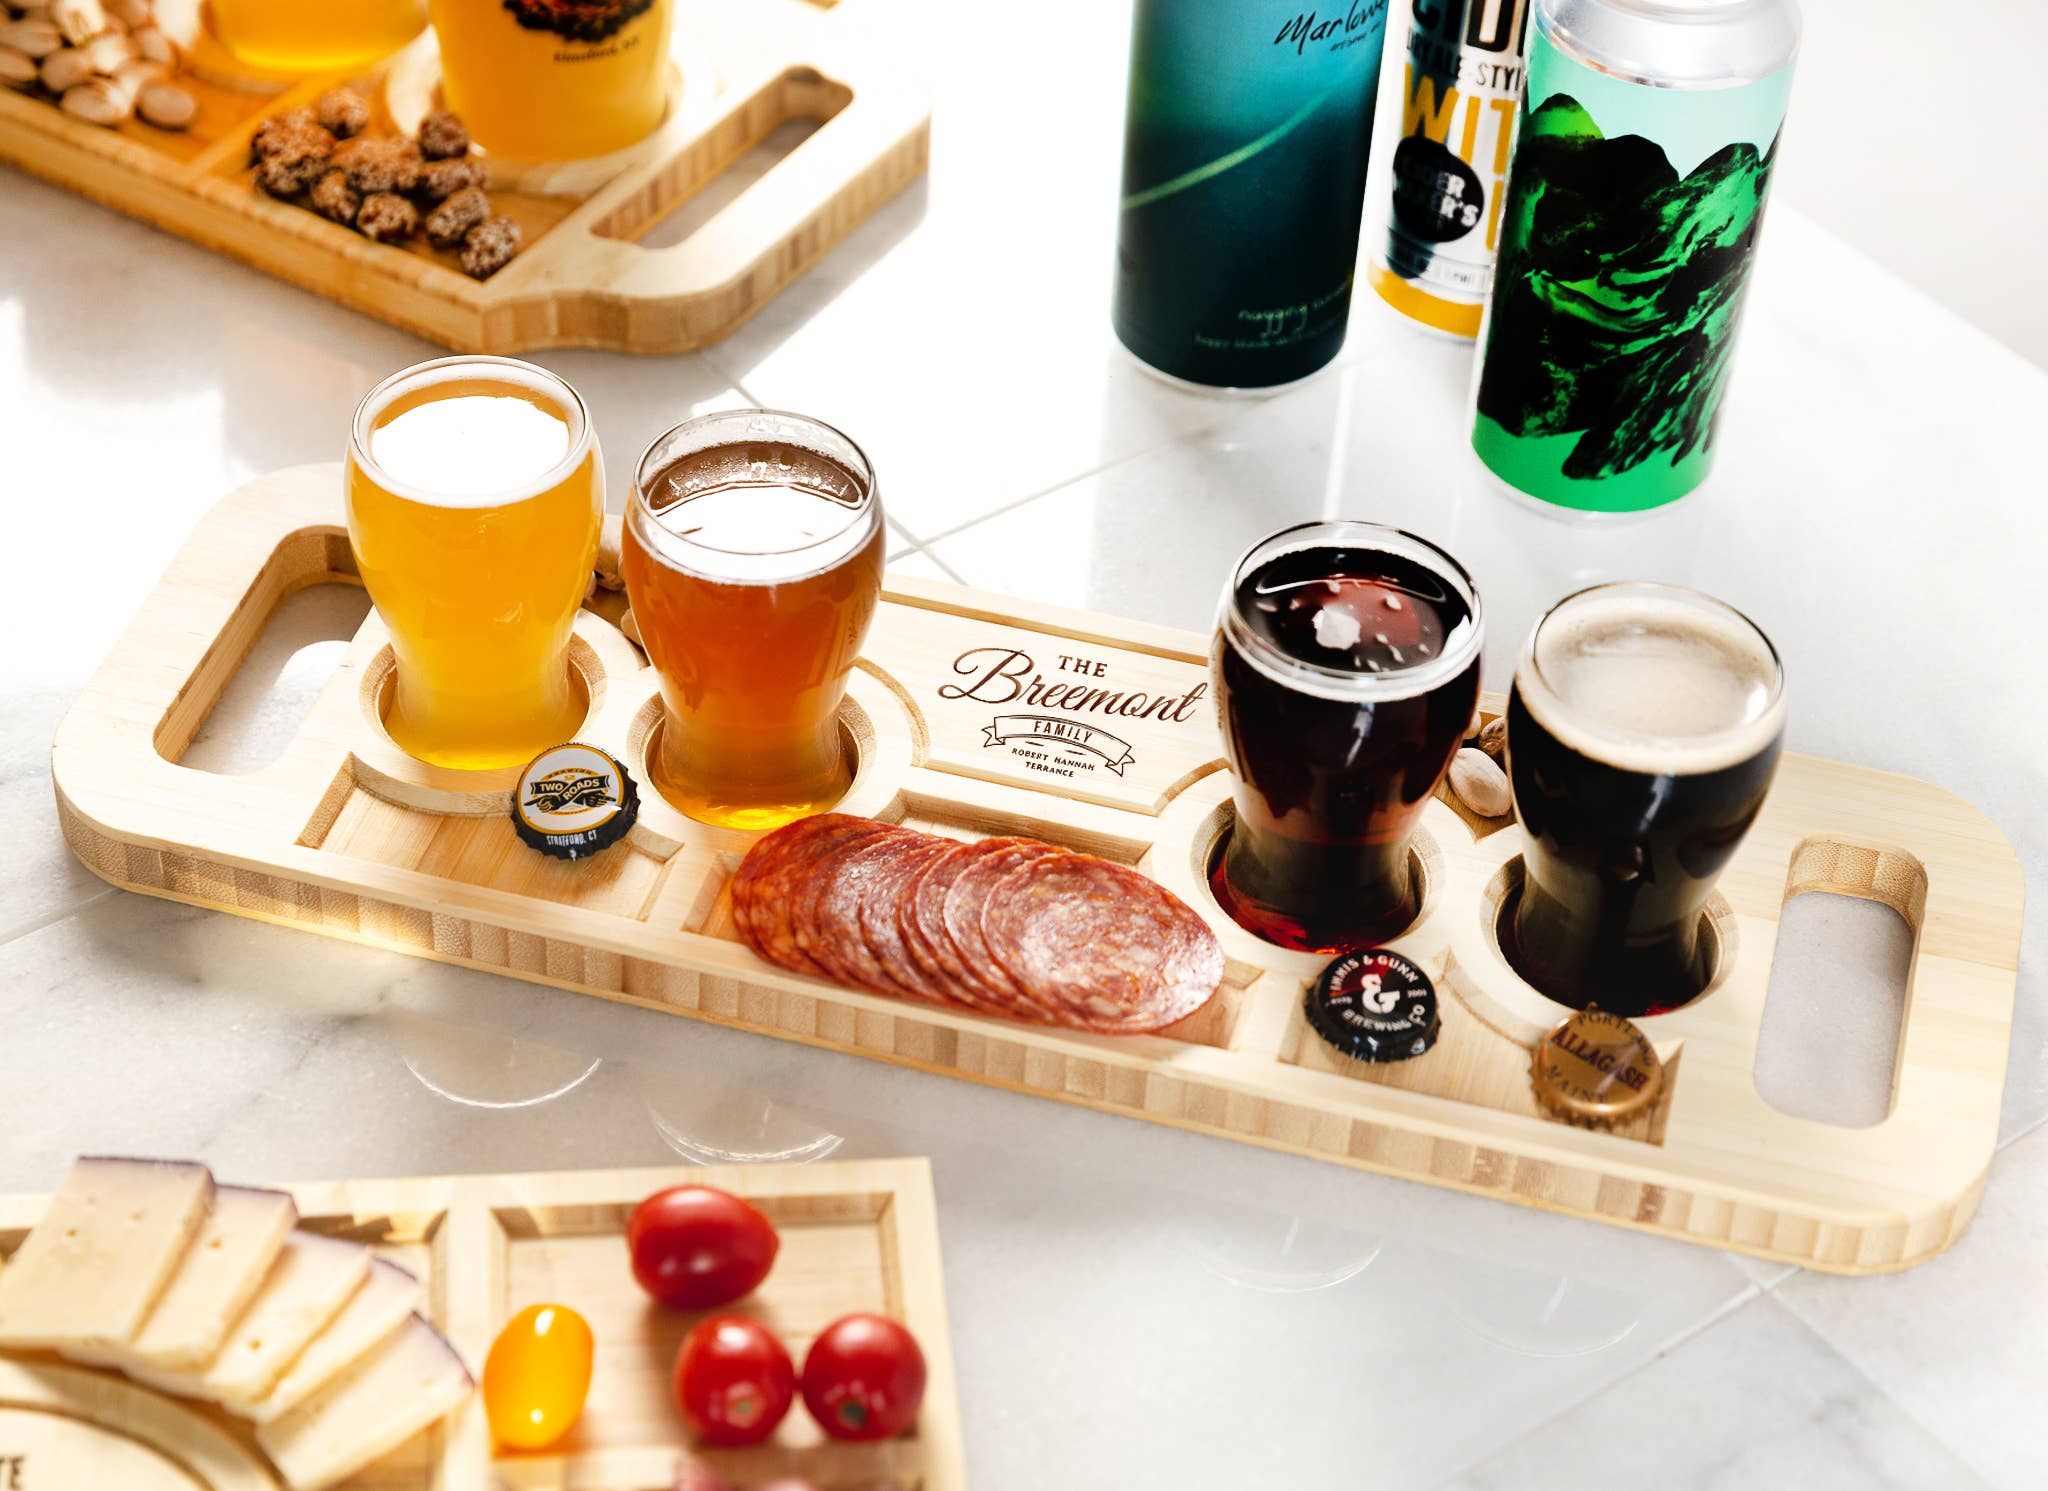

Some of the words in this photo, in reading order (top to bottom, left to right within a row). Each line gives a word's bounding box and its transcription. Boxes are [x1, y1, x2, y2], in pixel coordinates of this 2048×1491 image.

[1058, 654, 1108, 678] THE
[937, 647, 1209, 723] Breemont
[1033, 720, 1094, 744] FAMILY
[1011, 747, 1050, 762] ROBERT
[1053, 755, 1097, 772] HANNAH
[1025, 761, 1076, 778] TERRANCE
[539, 783, 564, 793] TWO
[562, 778, 600, 801] ROADS
[1329, 958, 1361, 991] INNIS
[1376, 954, 1420, 984] GUNN
[1341, 1008, 1413, 1032] BREWING
